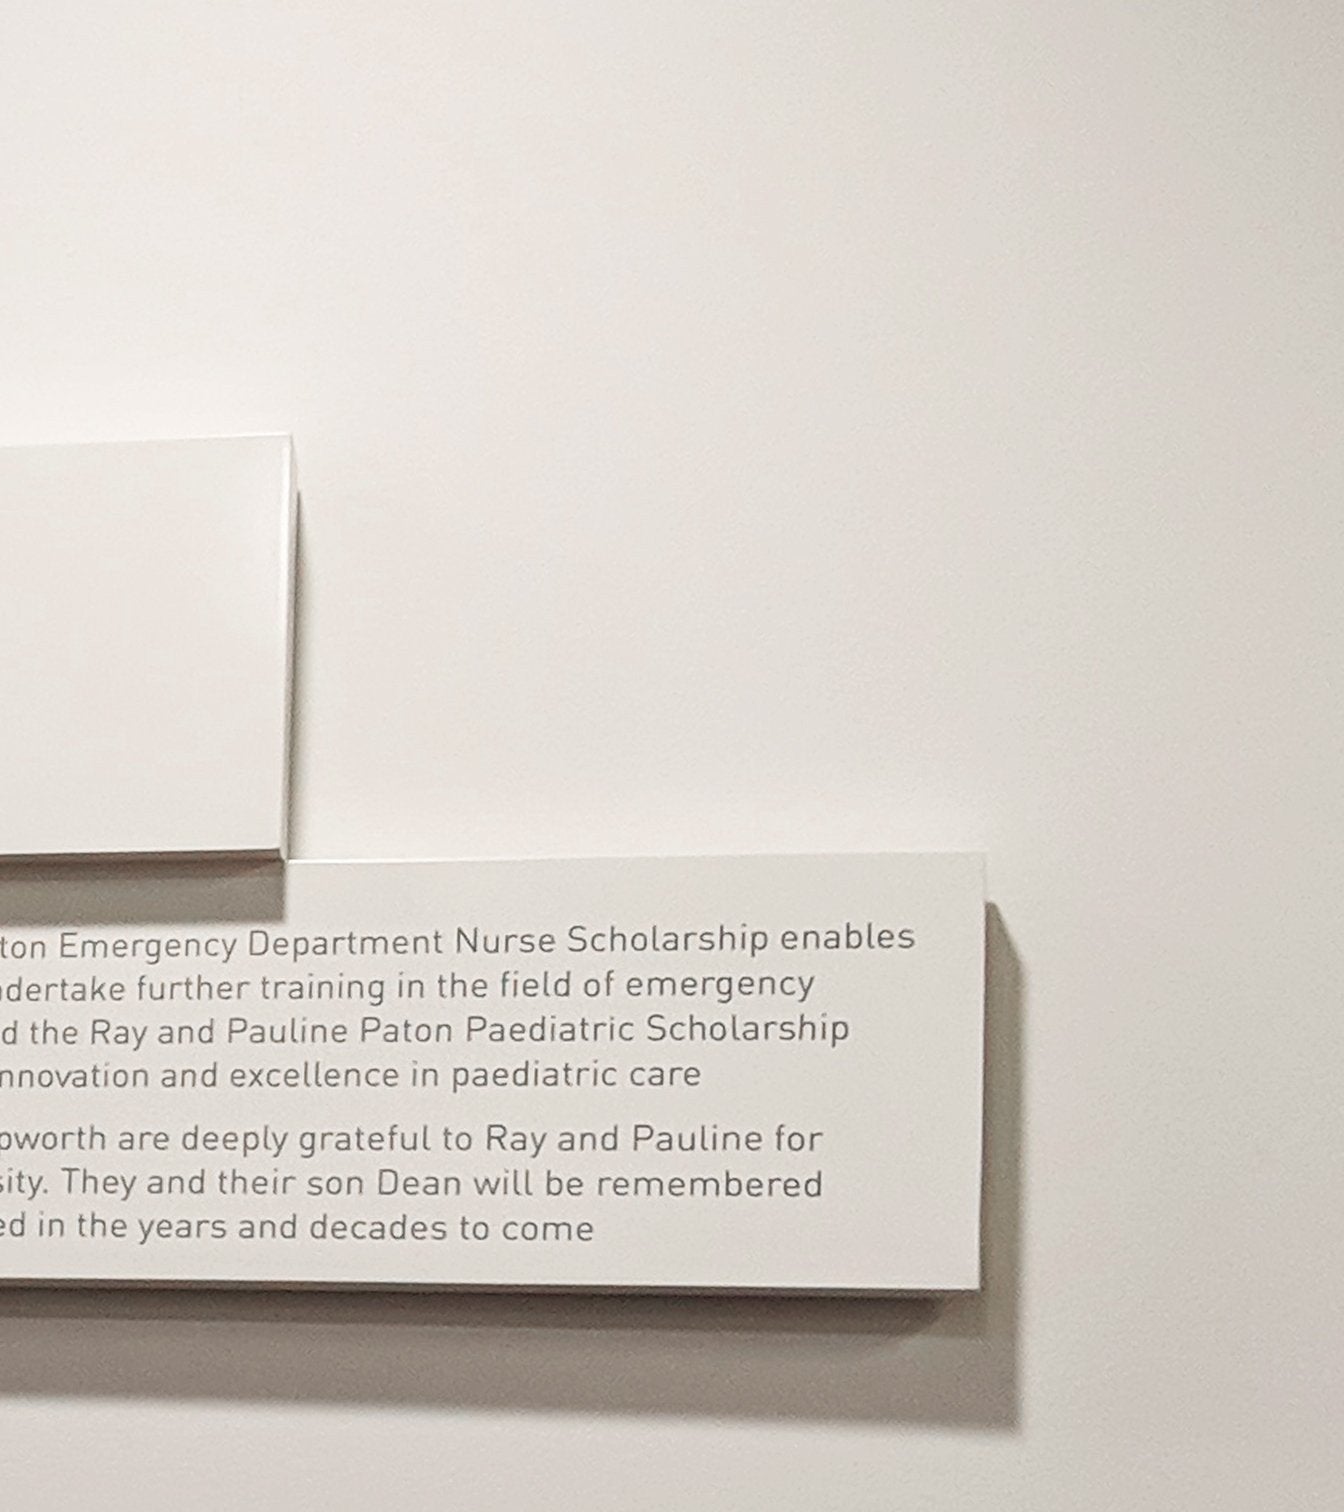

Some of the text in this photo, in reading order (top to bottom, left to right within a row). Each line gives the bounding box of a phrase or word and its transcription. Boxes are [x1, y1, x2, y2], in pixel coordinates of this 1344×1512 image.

[60, 932, 237, 966] Emergency
[248, 929, 444, 964] Department
[456, 926, 557, 955] Nurse
[567, 922, 769, 959] Scholarship
[780, 921, 916, 951] enables
[137, 973, 251, 1001] further
[260, 972, 385, 1007] training
[397, 971, 425, 999] in
[437, 971, 489, 999] the
[500, 970, 572, 998] field
[583, 969, 615, 998] of
[625, 975, 816, 1005] emergency
[29, 1018, 79, 1046] the
[90, 1018, 148, 1052] Ray
[157, 1017, 215, 1045] and
[227, 1016, 348, 1044] Pauline
[360, 1016, 452, 1044] Paton
[466, 1014, 635, 1043] Paediatric
[646, 1012, 850, 1049] Scholarship
[160, 1061, 218, 1089] and
[230, 1060, 400, 1088] excellence
[411, 1059, 439, 1088] in
[452, 1058, 618, 1094] paediatric
[629, 1066, 701, 1087] care
[118, 1131, 170, 1151] are
[181, 1124, 289, 1159] deeply
[299, 1123, 432, 1159] grateful
[442, 1126, 473, 1152] to
[486, 1123, 548, 1159] Ray
[557, 1123, 619, 1152] and
[632, 1123, 763, 1152] Pauline
[775, 1123, 824, 1152] for
[60, 1166, 138, 1202] They
[146, 1168, 206, 1195] and
[218, 1167, 297, 1196] their
[306, 1175, 364, 1197] son
[377, 1168, 461, 1196] Dean
[473, 1168, 534, 1197] will
[545, 1169, 584, 1197] be
[597, 1169, 822, 1198] remembered
[38, 1210, 65, 1238] in
[77, 1210, 128, 1239] the
[137, 1218, 227, 1246] years
[238, 1212, 297, 1240] and
[309, 1212, 448, 1241] decades
[459, 1215, 490, 1241] to
[502, 1220, 594, 1242] come
